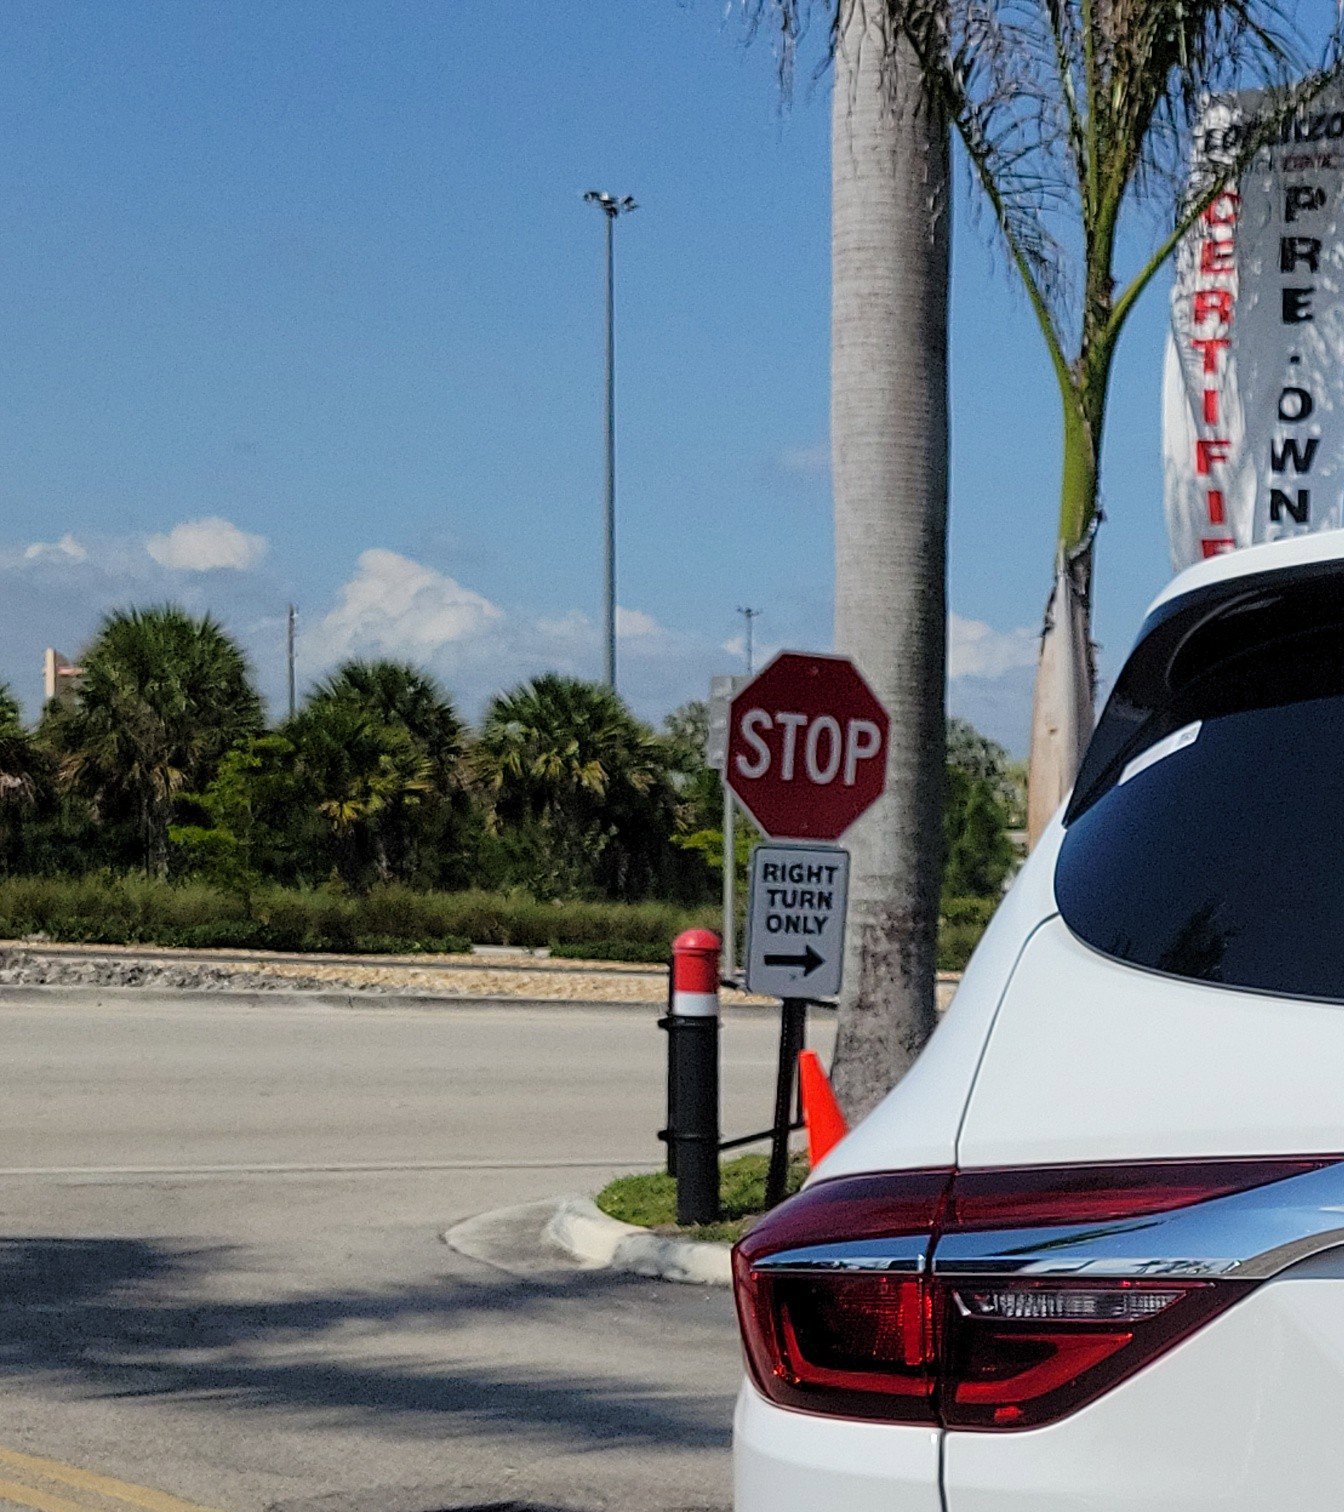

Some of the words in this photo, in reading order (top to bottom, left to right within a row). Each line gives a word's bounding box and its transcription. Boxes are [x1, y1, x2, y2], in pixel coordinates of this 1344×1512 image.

[736, 708, 881, 785] STOP
[763, 863, 838, 884] RIGHT
[767, 889, 832, 909] TURN
[766, 914, 828, 933] ONLY
